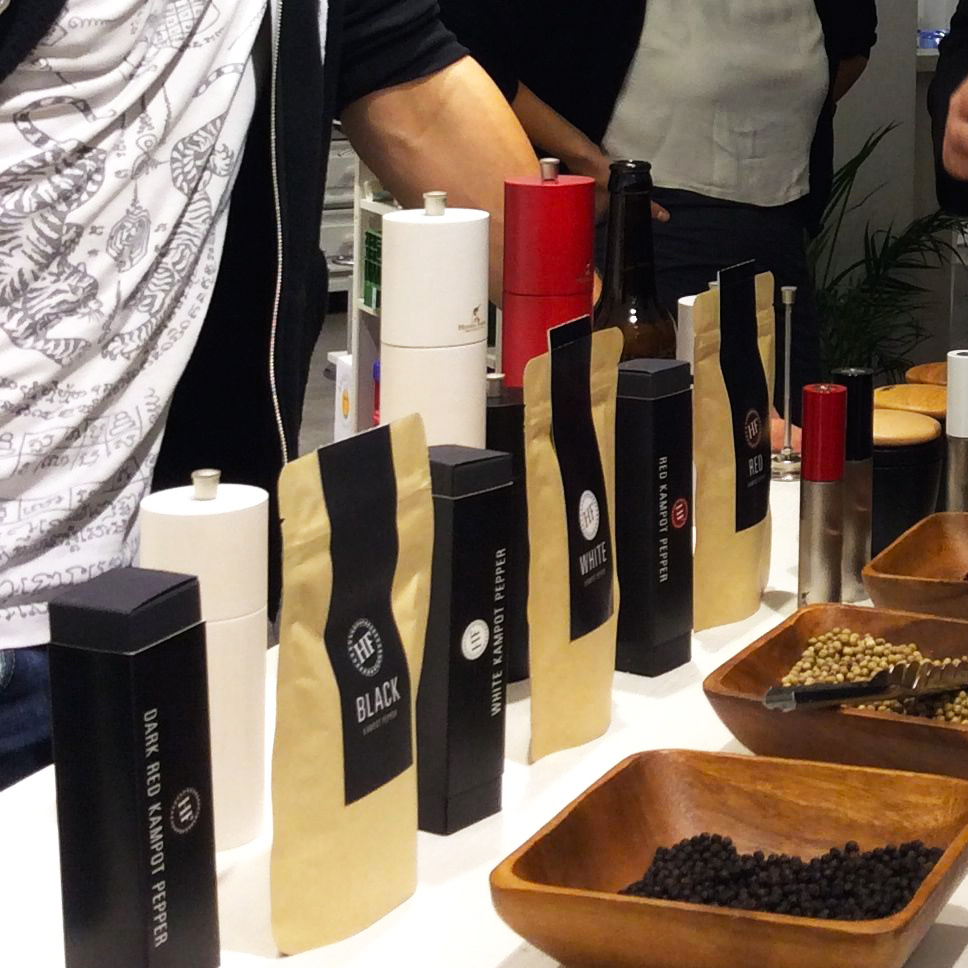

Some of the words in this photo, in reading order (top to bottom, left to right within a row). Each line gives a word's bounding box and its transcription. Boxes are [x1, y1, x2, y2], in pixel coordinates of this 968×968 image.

[658, 456, 669, 480] RED
[748, 453, 764, 477] RED
[659, 484, 669, 533] KAMPOT
[494, 547, 507, 602] PEPPER
[579, 541, 608, 576] WHITE
[659, 537, 669, 583] PEPPER
[492, 607, 505, 666] KAMPOT
[356, 676, 401, 723] BLACK
[490, 670, 503, 717] WHITE
[143, 708, 160, 759] DARK
[146, 761, 161, 798] RED
[148, 801, 166, 875] KAMPOT
[151, 880, 169, 948] PEPPER
